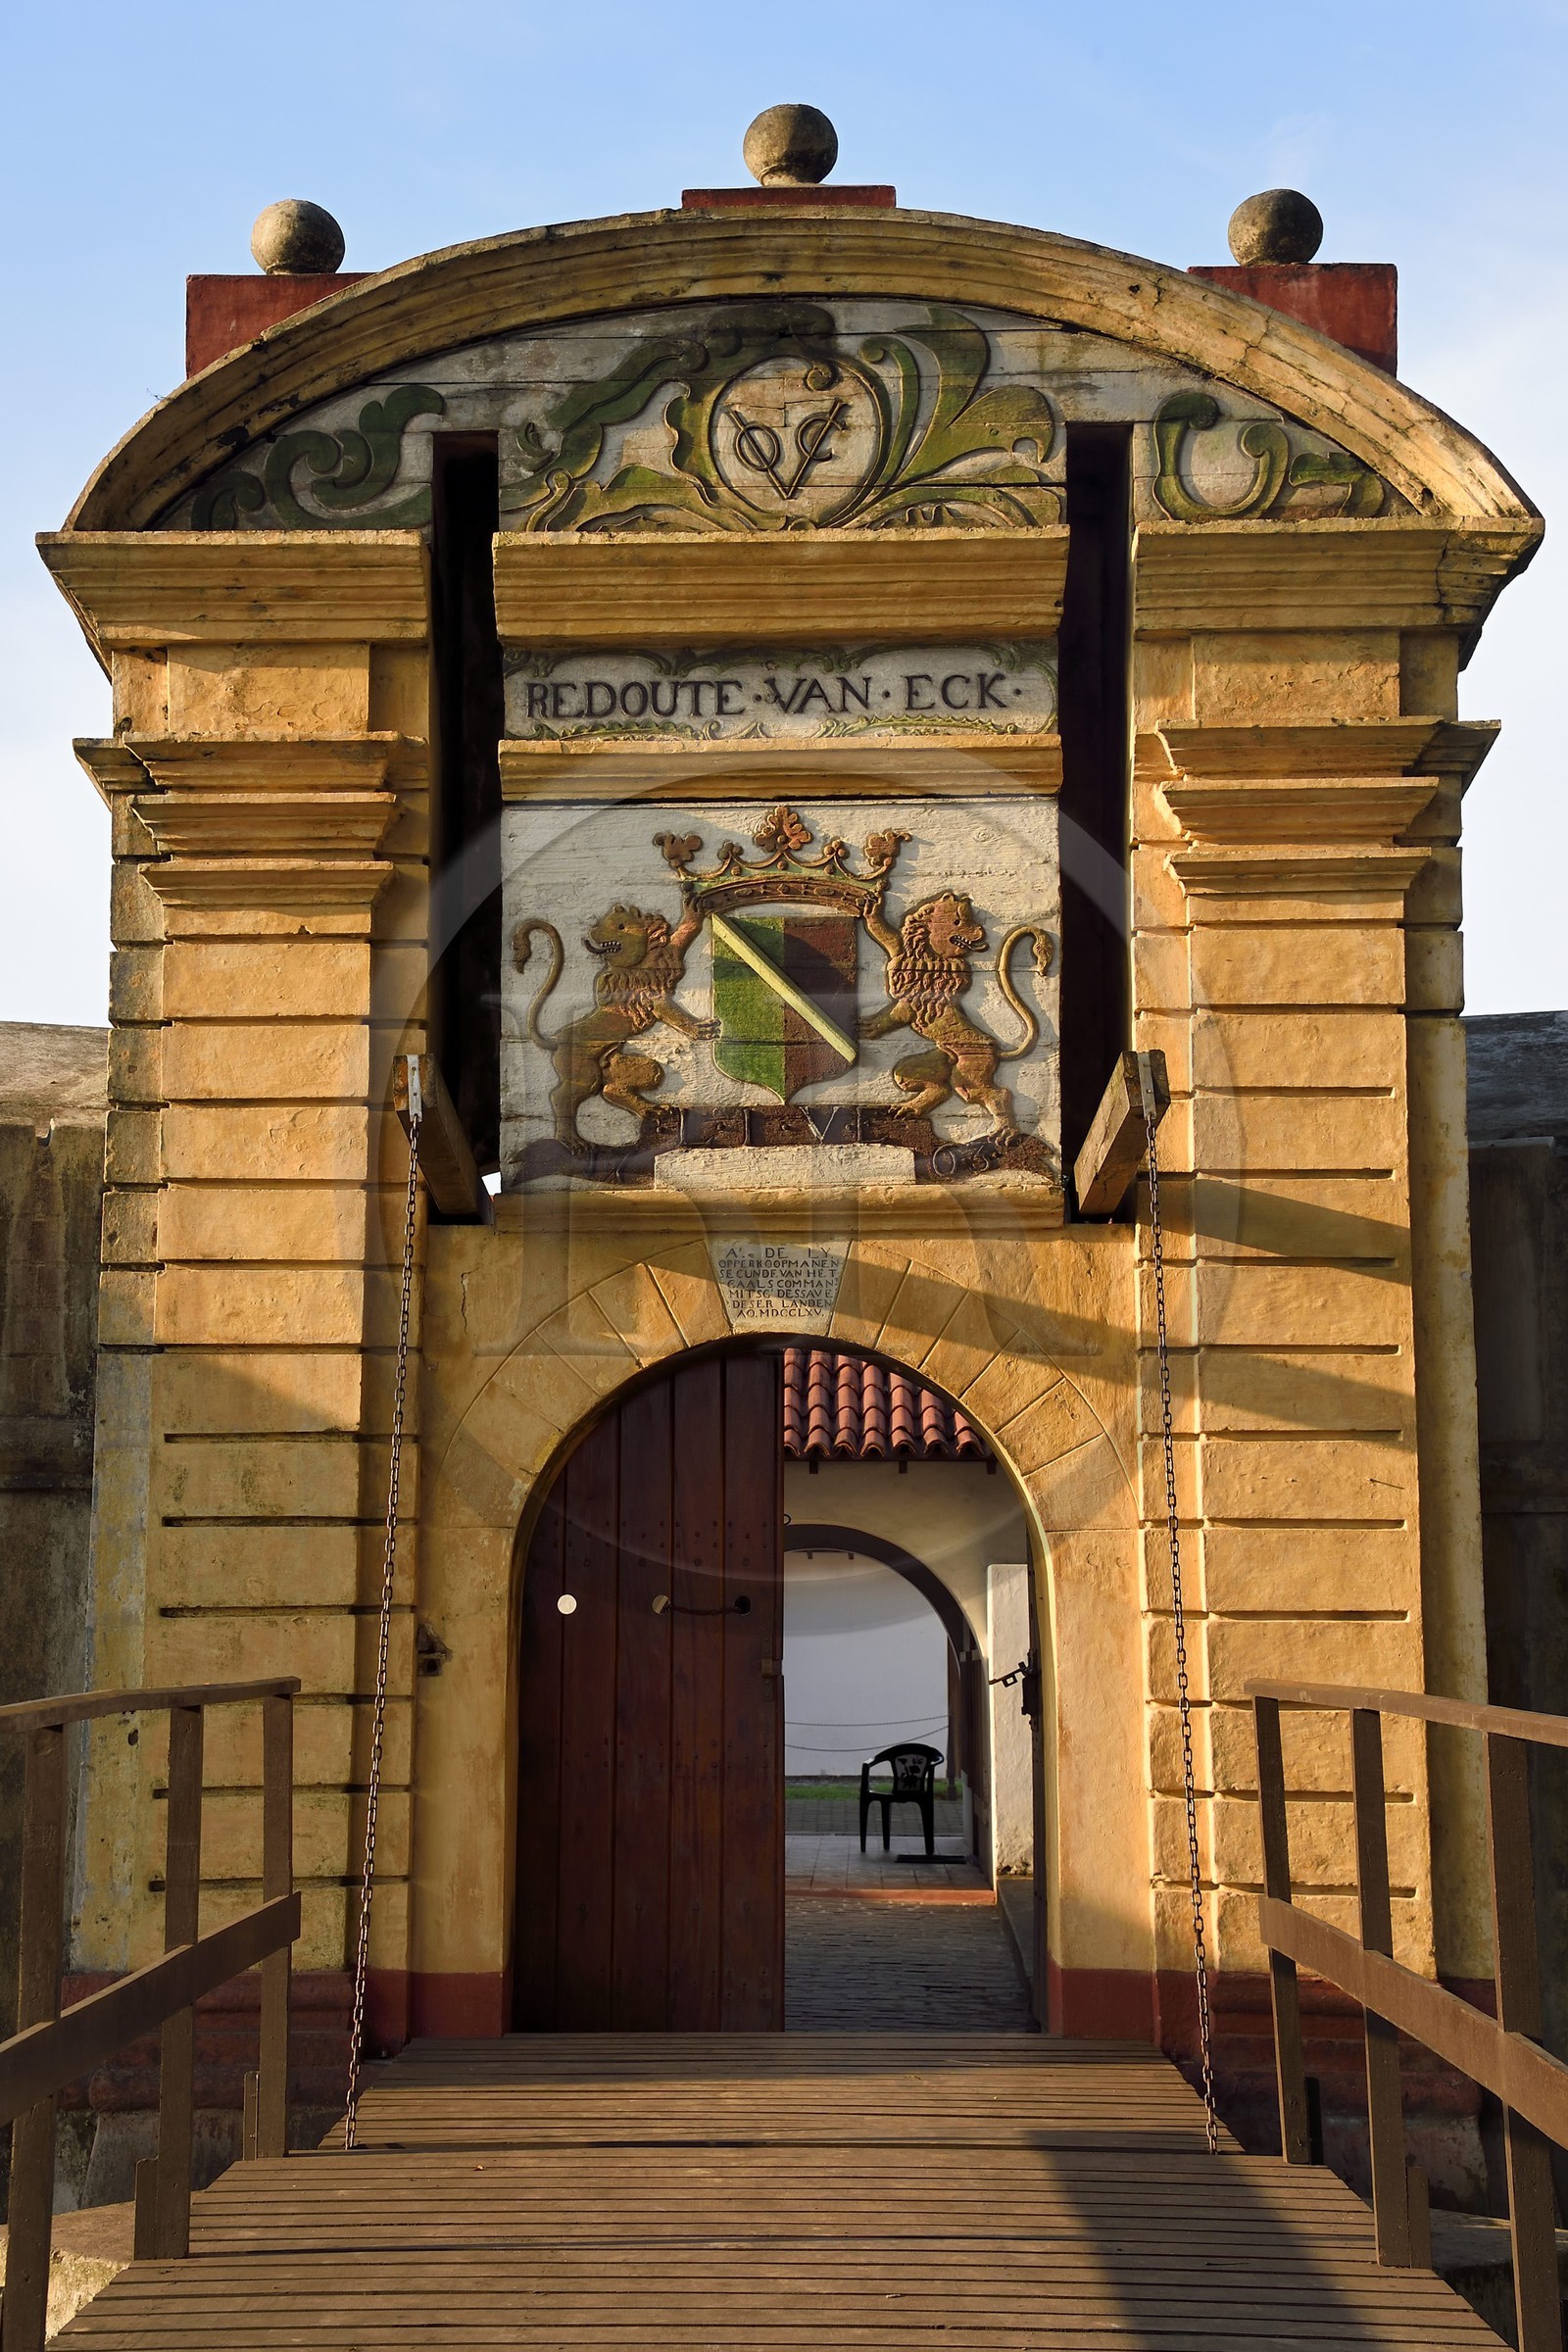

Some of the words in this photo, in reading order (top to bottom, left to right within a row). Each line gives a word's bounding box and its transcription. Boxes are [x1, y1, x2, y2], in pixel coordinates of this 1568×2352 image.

[525, 678, 747, 719] REDOUTE
[763, 675, 873, 715] VAN
[764, 1247, 789, 1259] DE
[779, 1269, 803, 1279] VAN
[807, 1268, 837, 1278] HET
[732, 1299, 774, 1309] DESER
[781, 1298, 833, 1309] LANDEN
